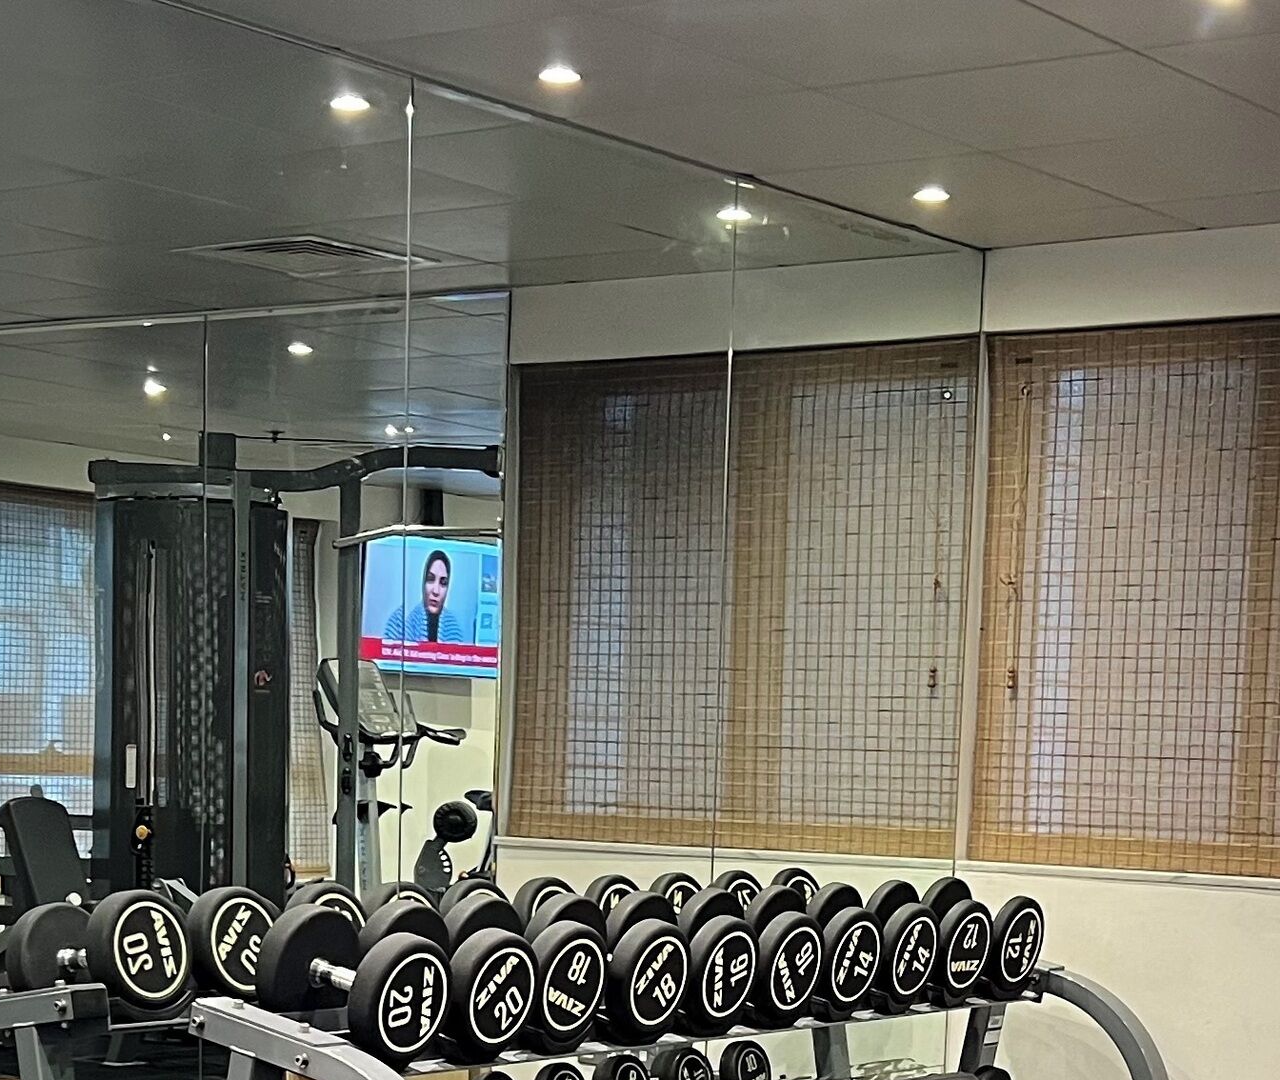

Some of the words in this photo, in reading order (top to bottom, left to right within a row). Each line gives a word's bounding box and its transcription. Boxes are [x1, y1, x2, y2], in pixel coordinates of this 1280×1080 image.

[896, 923, 923, 978] ZIVA
[963, 923, 979, 949] 12
[1005, 932, 1022, 960] 12
[1019, 919, 1037, 974] ZIVA
[567, 951, 592, 986] 18
[635, 943, 675, 996] ZIVA
[730, 953, 749, 988] 16
[795, 941, 815, 976] 16
[835, 928, 863, 986] ZIVA
[853, 950, 874, 977] 14
[911, 945, 930, 973] 14
[951, 959, 980, 972] ZIVA
[475, 955, 520, 1011] ZIVA
[652, 972, 677, 1008] 18
[713, 947, 724, 1008] ZIVA
[778, 952, 796, 1003] ZIVA
[388, 985, 414, 1029] 20
[419, 965, 435, 1038] ZIVA
[493, 985, 524, 1032] 20
[548, 986, 586, 1017] ZIVA
